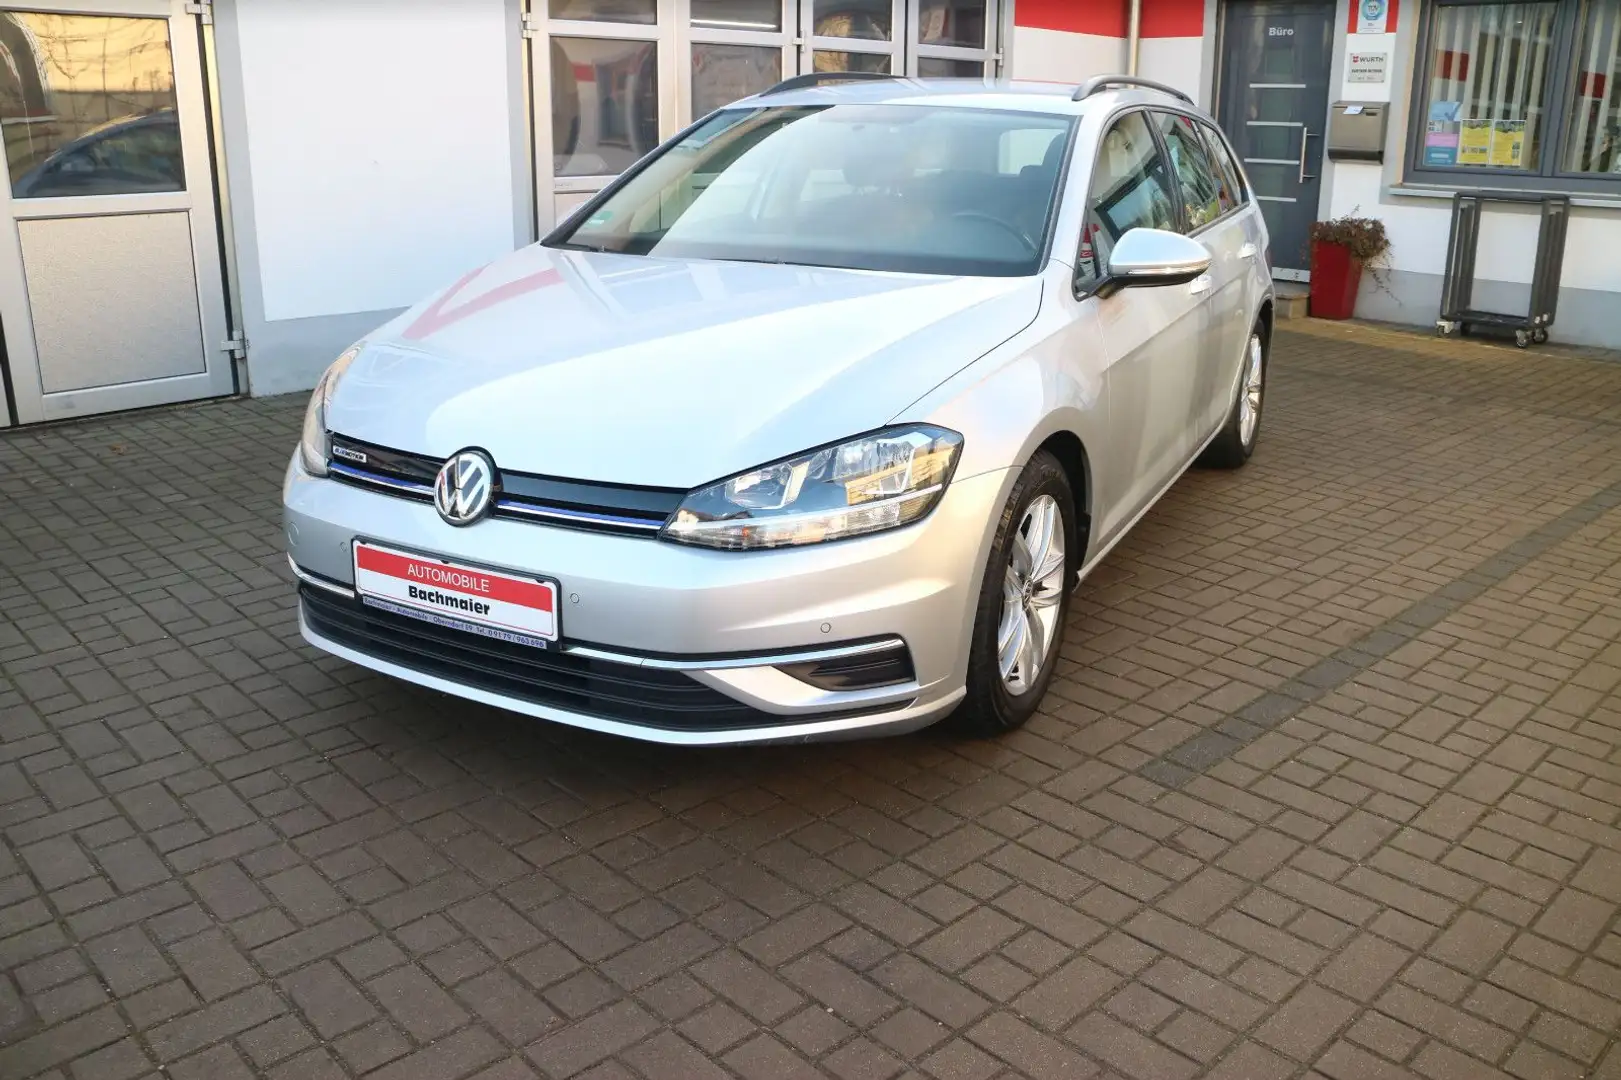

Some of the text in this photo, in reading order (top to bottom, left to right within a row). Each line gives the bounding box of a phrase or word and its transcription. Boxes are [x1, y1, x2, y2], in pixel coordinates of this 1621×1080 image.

[1268, 26, 1294, 36] Büro
[407, 563, 490, 593] AUTOMOBILE
[408, 585, 490, 616] Bachmaier
